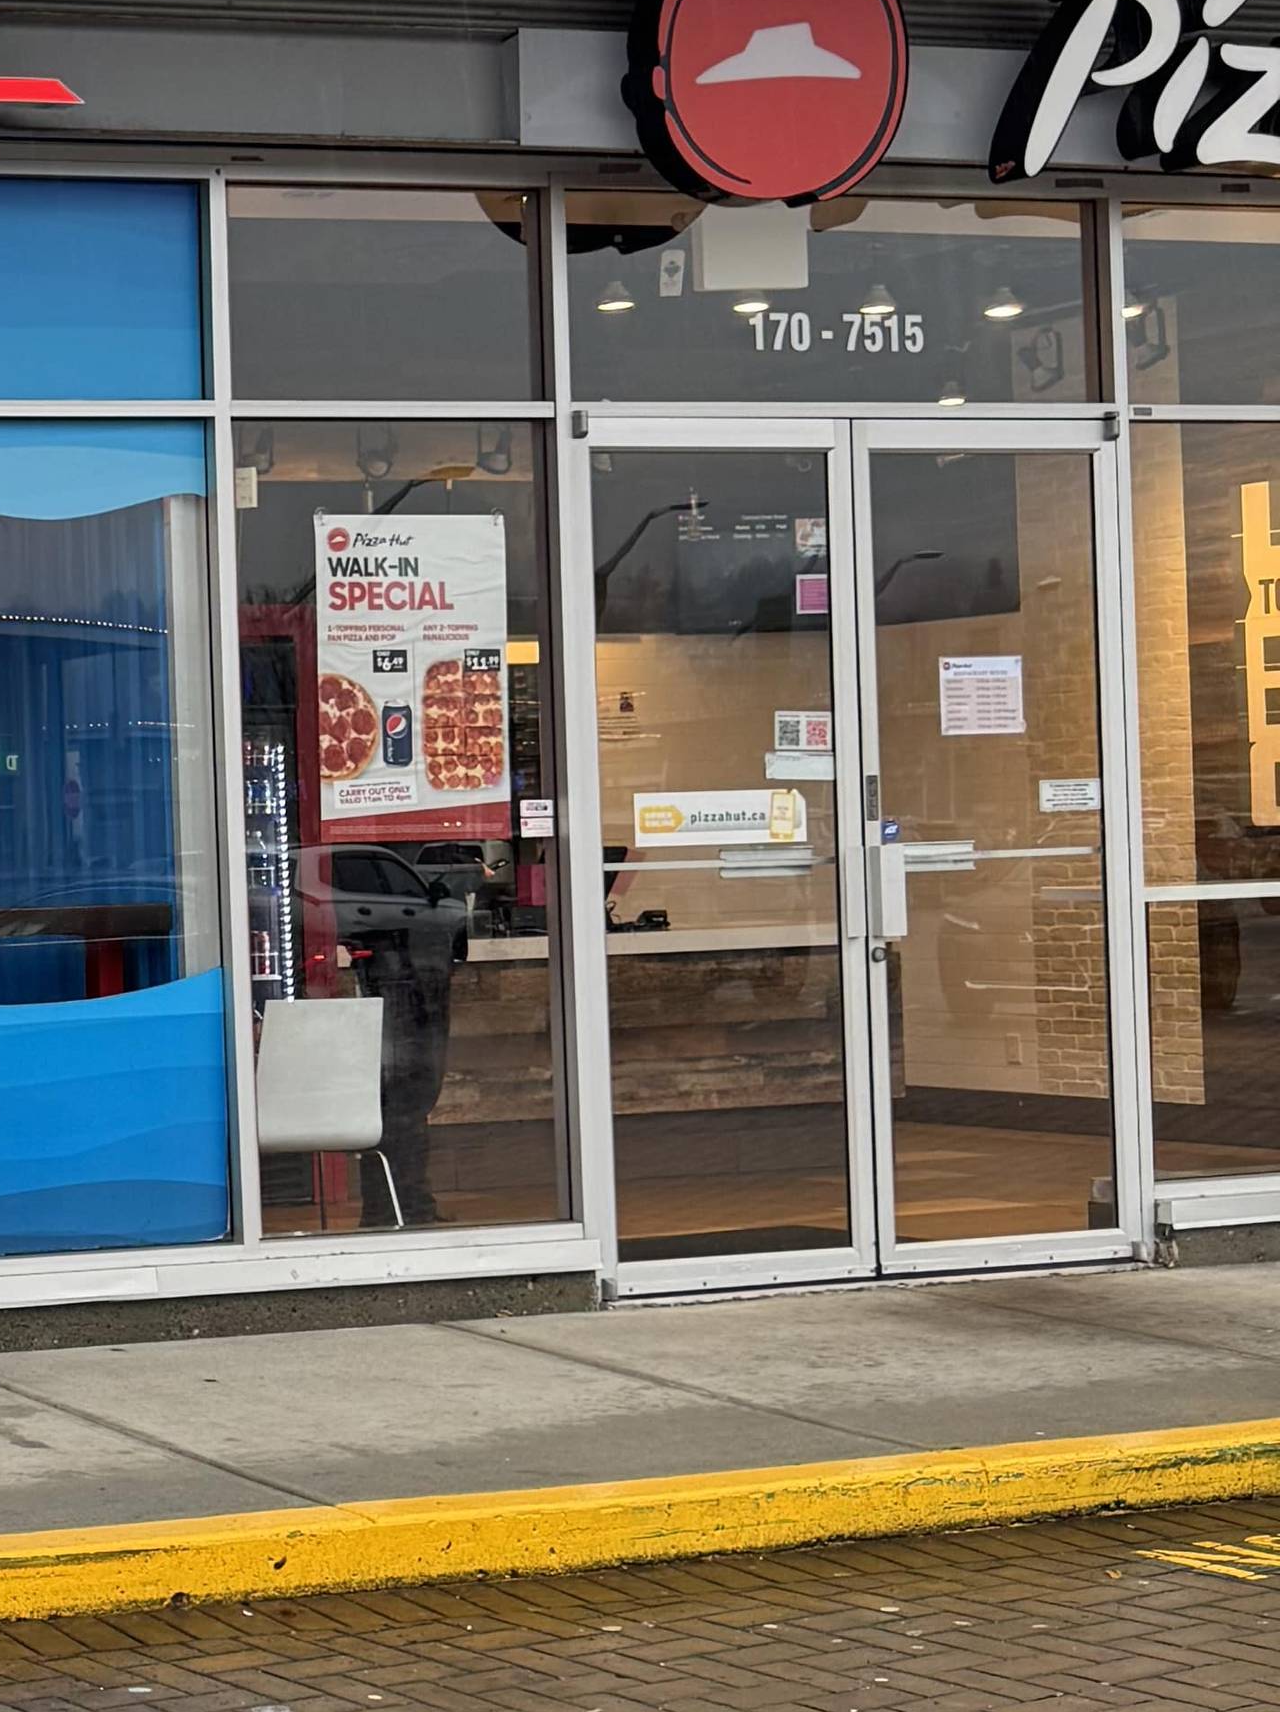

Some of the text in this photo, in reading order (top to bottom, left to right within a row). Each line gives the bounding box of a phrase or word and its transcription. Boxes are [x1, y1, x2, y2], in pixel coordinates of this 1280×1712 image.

[748, 311, 811, 351] 170
[842, 312, 925, 353] 7515
[352, 532, 415, 548] Pizza Hut
[327, 556, 420, 577] WALK-IN
[328, 580, 455, 611] SPECIAL
[368, 787, 387, 796] OUT
[388, 785, 411, 794] ONLY
[691, 810, 766, 826] pizzahut.ca
